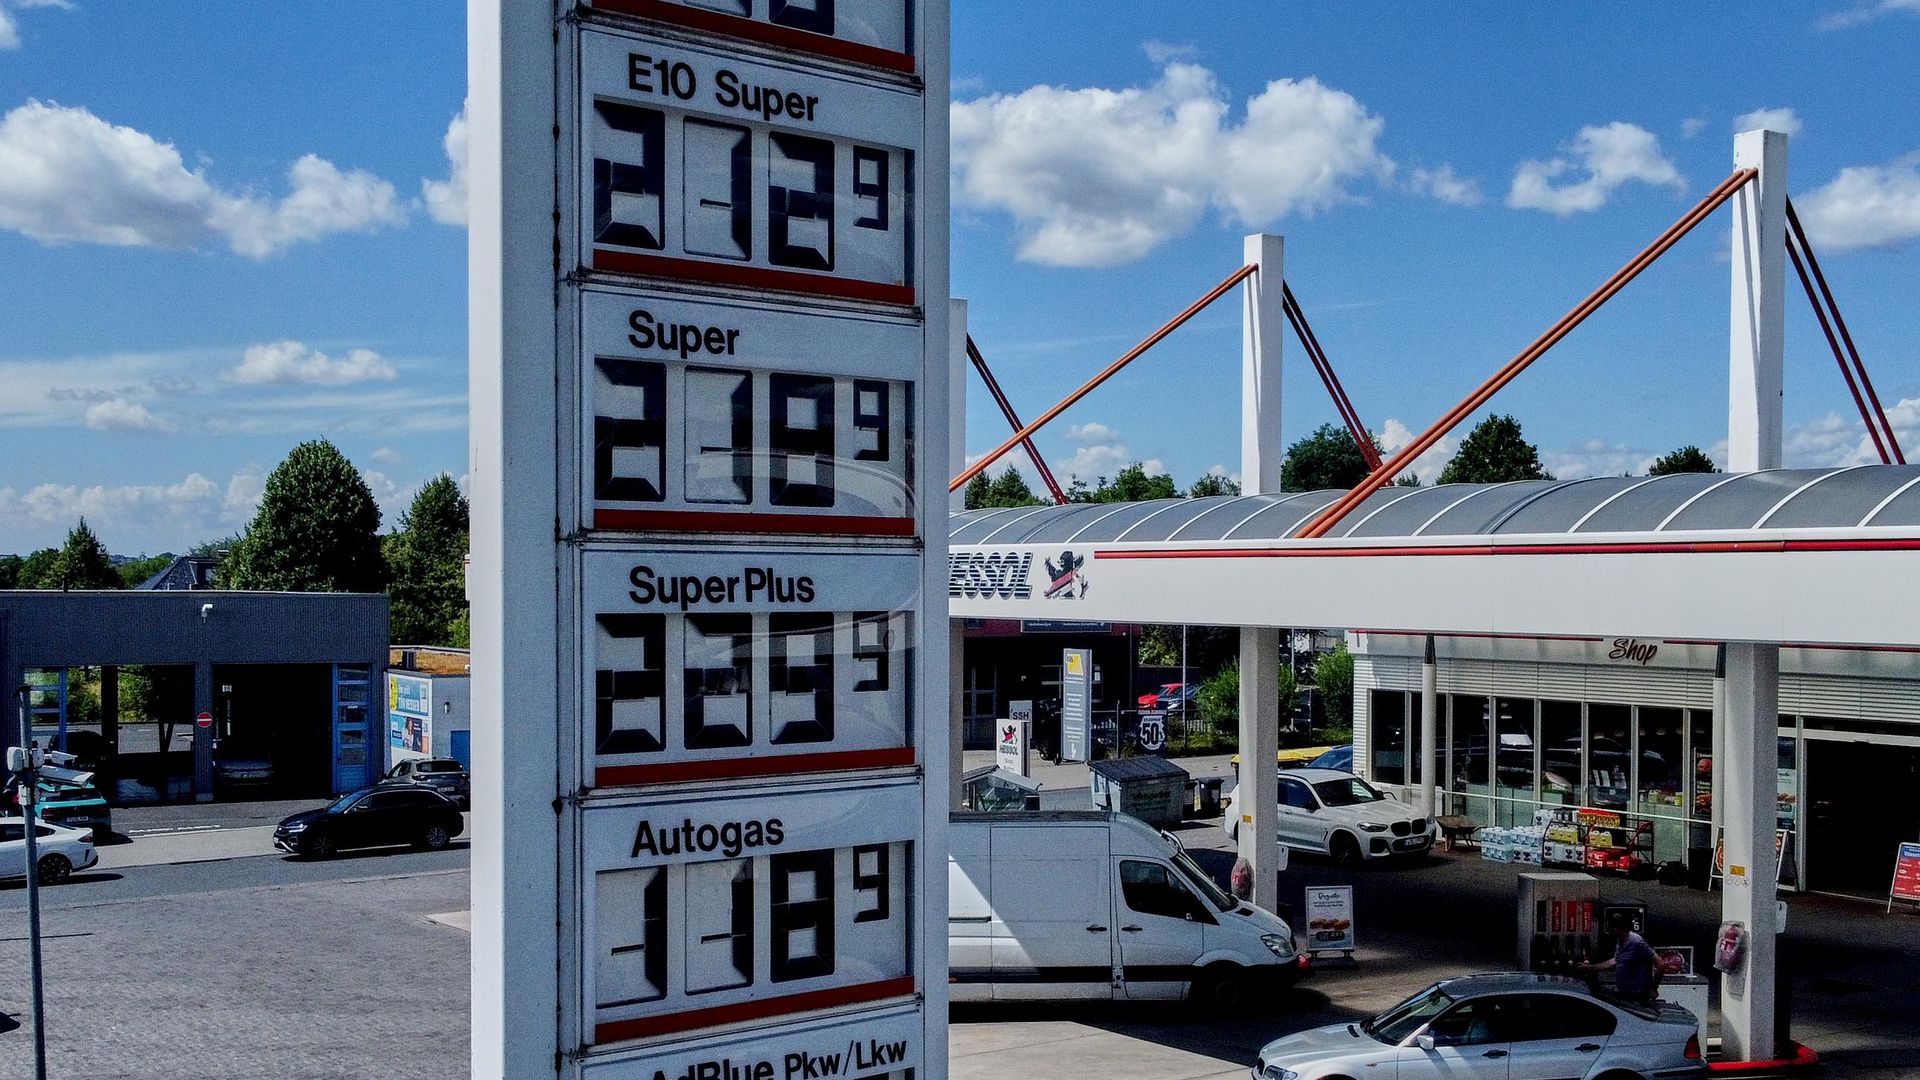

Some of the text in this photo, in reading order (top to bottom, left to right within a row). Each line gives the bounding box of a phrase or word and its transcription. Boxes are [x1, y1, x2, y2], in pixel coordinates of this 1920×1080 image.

[629, 53, 819, 122] E10 Super
[628, 309, 740, 359] Super
[949, 552, 1033, 600] ESSOL
[1608, 638, 1658, 666] Shop
[1012, 711, 1030, 720] SSH
[1141, 722, 1160, 746] 50
[631, 818, 785, 858] Autogas
[784, 1040, 908, 1080] Pkw/Lkw
